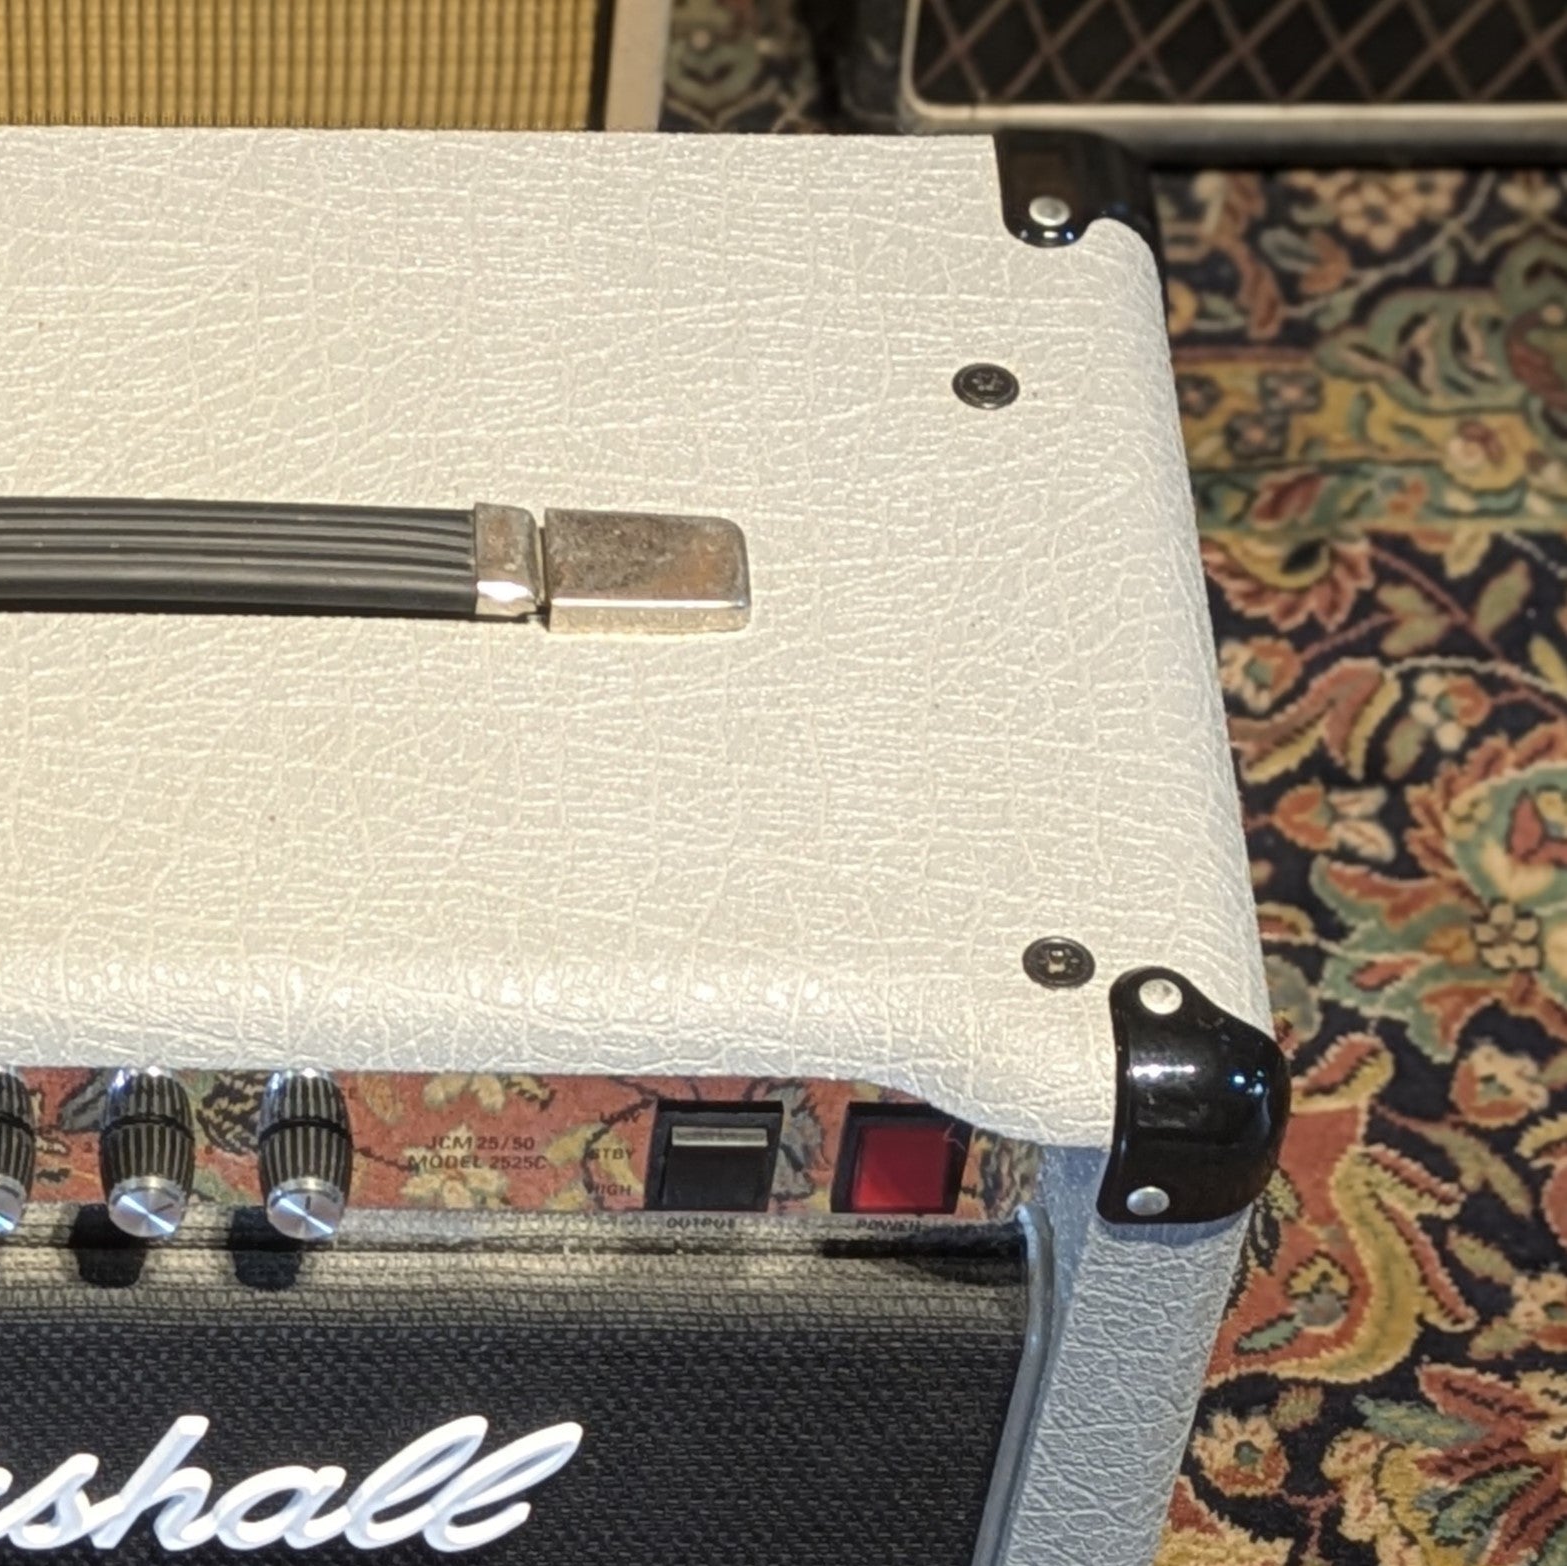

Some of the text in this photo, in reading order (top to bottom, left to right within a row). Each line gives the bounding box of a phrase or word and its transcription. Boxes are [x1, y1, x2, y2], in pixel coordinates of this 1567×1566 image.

[427, 1135, 535, 1151] JCM 25/50
[589, 1147, 635, 1161] STBY
[408, 1154, 548, 1170] MODEL 2525C
[593, 1183, 632, 1196] HIGH
[666, 1216, 735, 1229] OUTPUT
